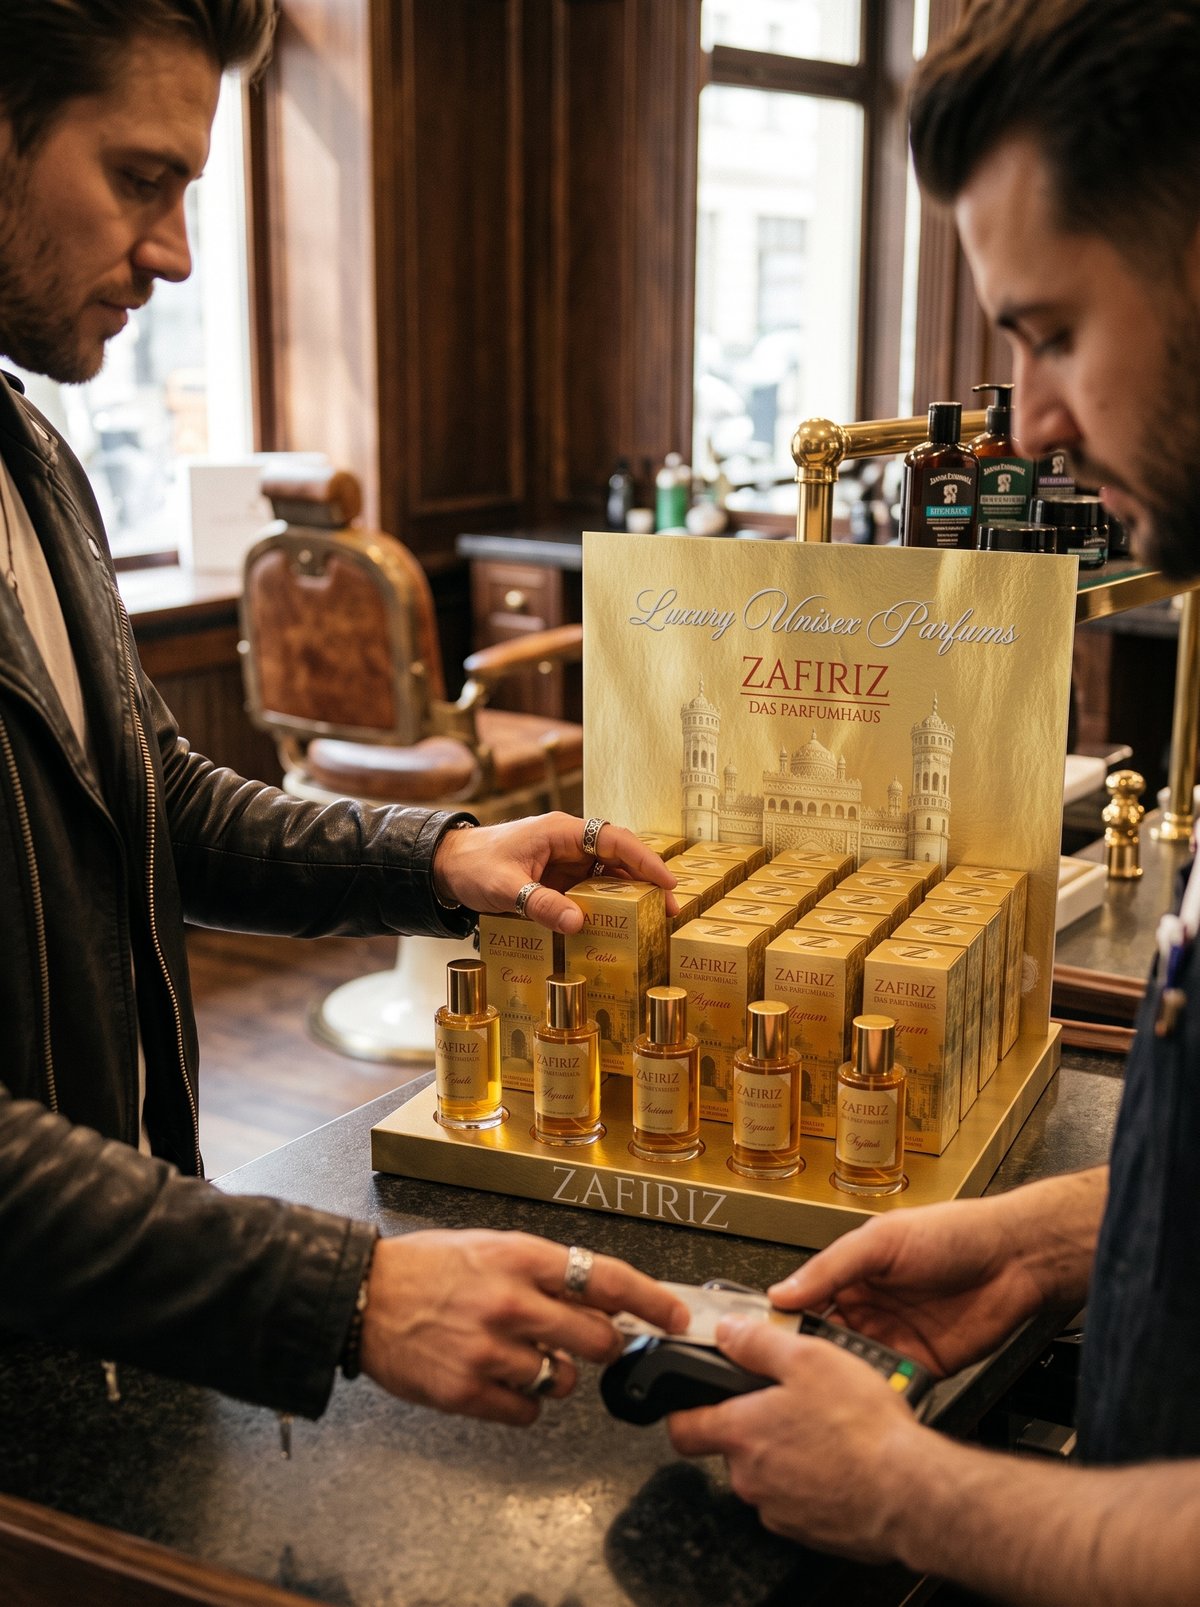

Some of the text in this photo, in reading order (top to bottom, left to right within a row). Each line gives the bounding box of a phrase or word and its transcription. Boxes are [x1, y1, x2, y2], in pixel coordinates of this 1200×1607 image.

[629, 587, 1020, 656] Luxury Unisex Parfums
[741, 655, 890, 698] ZAFIRIZ
[749, 700, 881, 724] DAS PARFUMHAUS
[583, 913, 628, 930] AFIRIZ
[489, 932, 544, 952] ZAFIRIZ
[680, 955, 737, 975] ZAFIRIZ
[775, 967, 835, 988] ZAFIRIZ
[874, 978, 937, 1000] ZAFIRIZ
[437, 1038, 480, 1055] ZAFIRIZ
[536, 1053, 581, 1069] ZAFIRIZ
[636, 1068, 680, 1084] ZAFIRIZ
[736, 1084, 783, 1100] ZAFIRIZ
[841, 1099, 889, 1116] ZAFIRIZ
[552, 1165, 729, 1229] ZAFIRIZ
